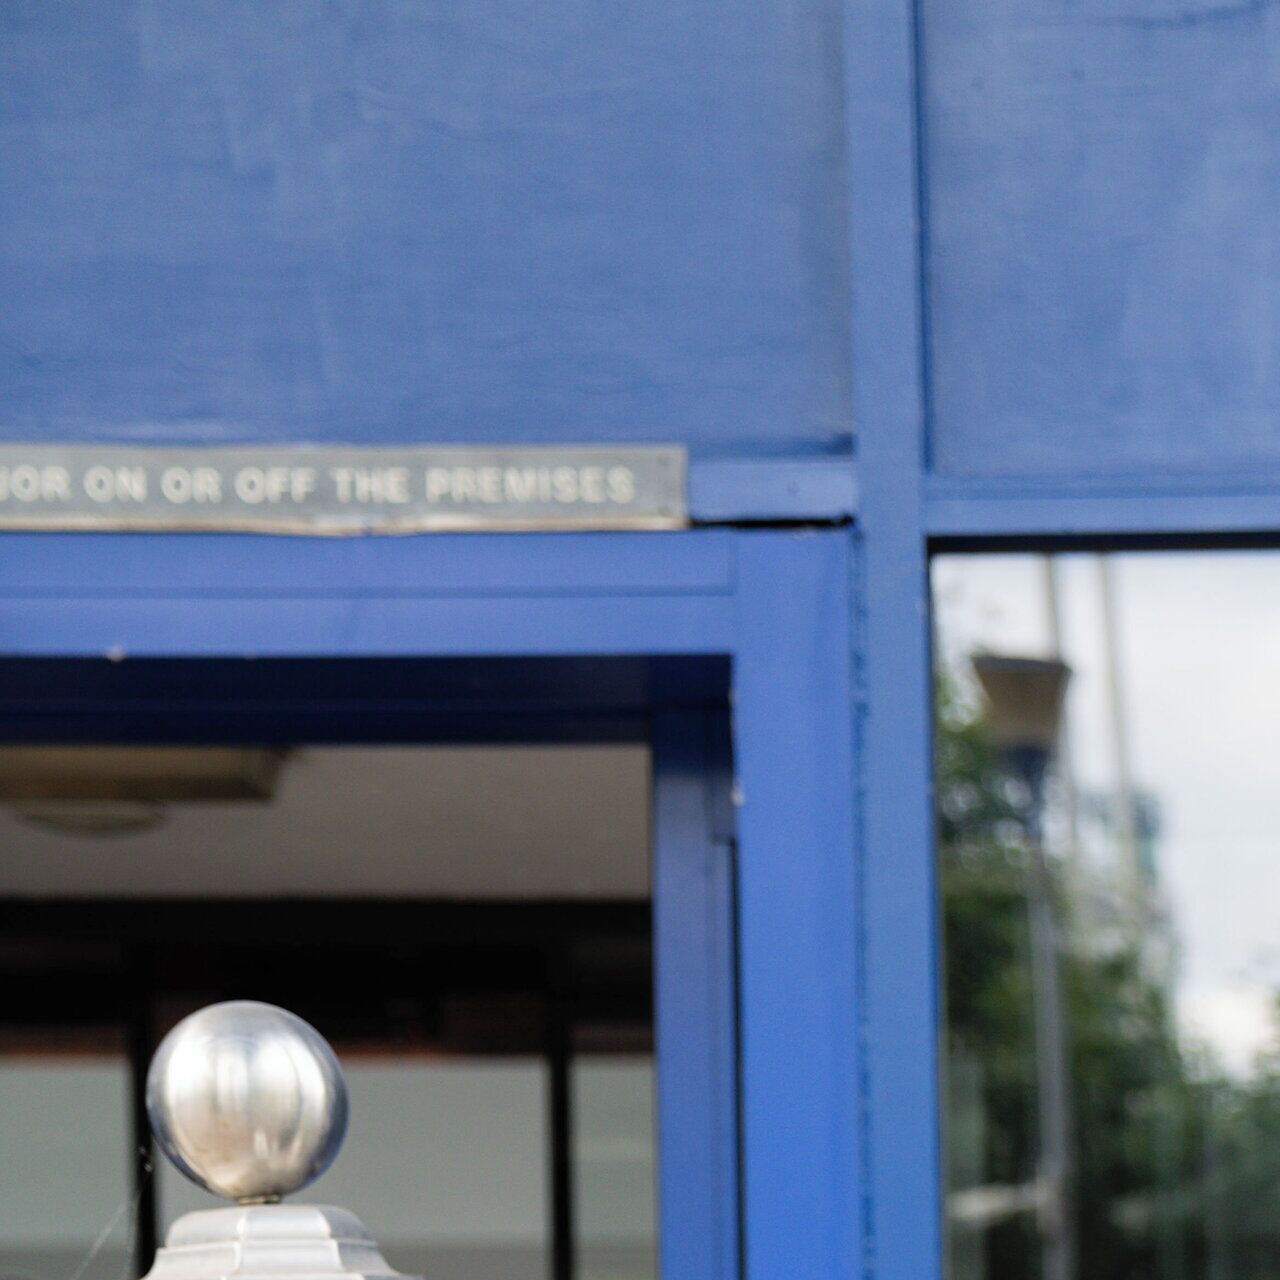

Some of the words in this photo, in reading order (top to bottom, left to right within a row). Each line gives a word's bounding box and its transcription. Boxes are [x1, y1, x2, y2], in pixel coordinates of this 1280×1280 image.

[83, 465, 148, 503] ON
[160, 466, 223, 504] OR
[234, 466, 316, 504] OFF
[330, 466, 411, 504] THE
[425, 465, 635, 504] PREMISES
